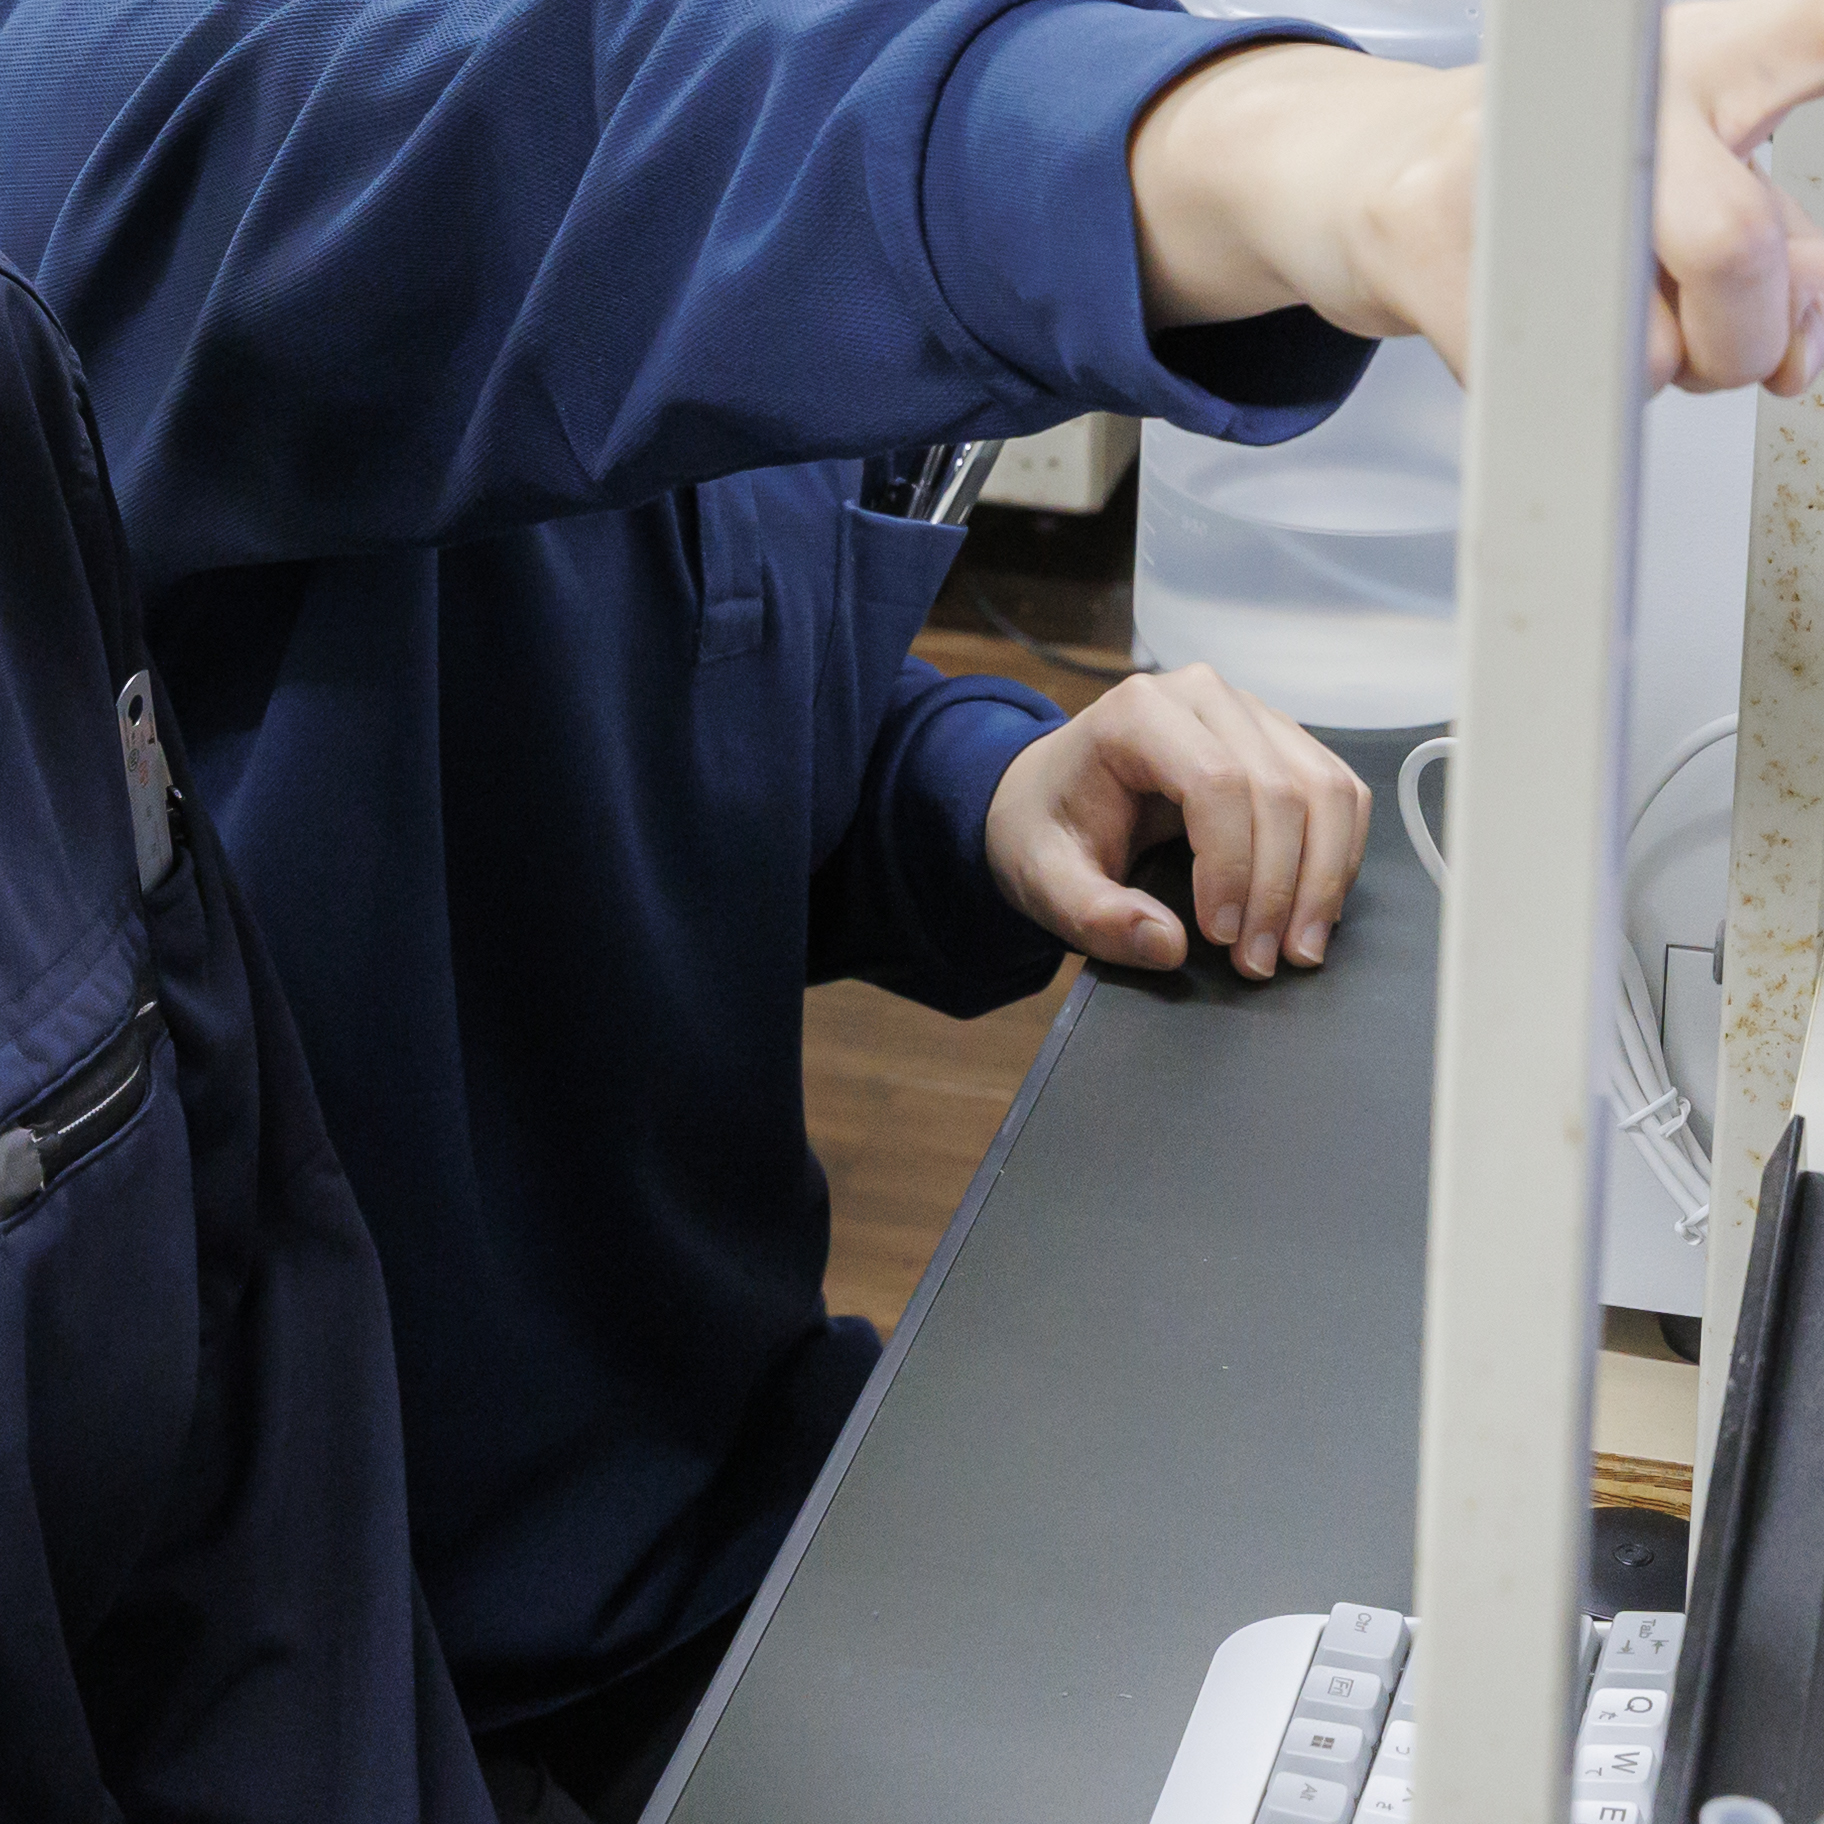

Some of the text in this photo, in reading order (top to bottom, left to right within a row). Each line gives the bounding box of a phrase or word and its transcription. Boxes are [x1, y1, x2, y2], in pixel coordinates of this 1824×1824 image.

[1355, 1612, 1372, 1633] Ctrl
[1639, 1619, 1657, 1639] Tab
[1333, 1679, 1349, 1697] Fn
[1624, 1696, 1653, 1714] Q
[1611, 1751, 1640, 1774] W
[1300, 1783, 1317, 1802] Alt
[1599, 1806, 1627, 1822] E
